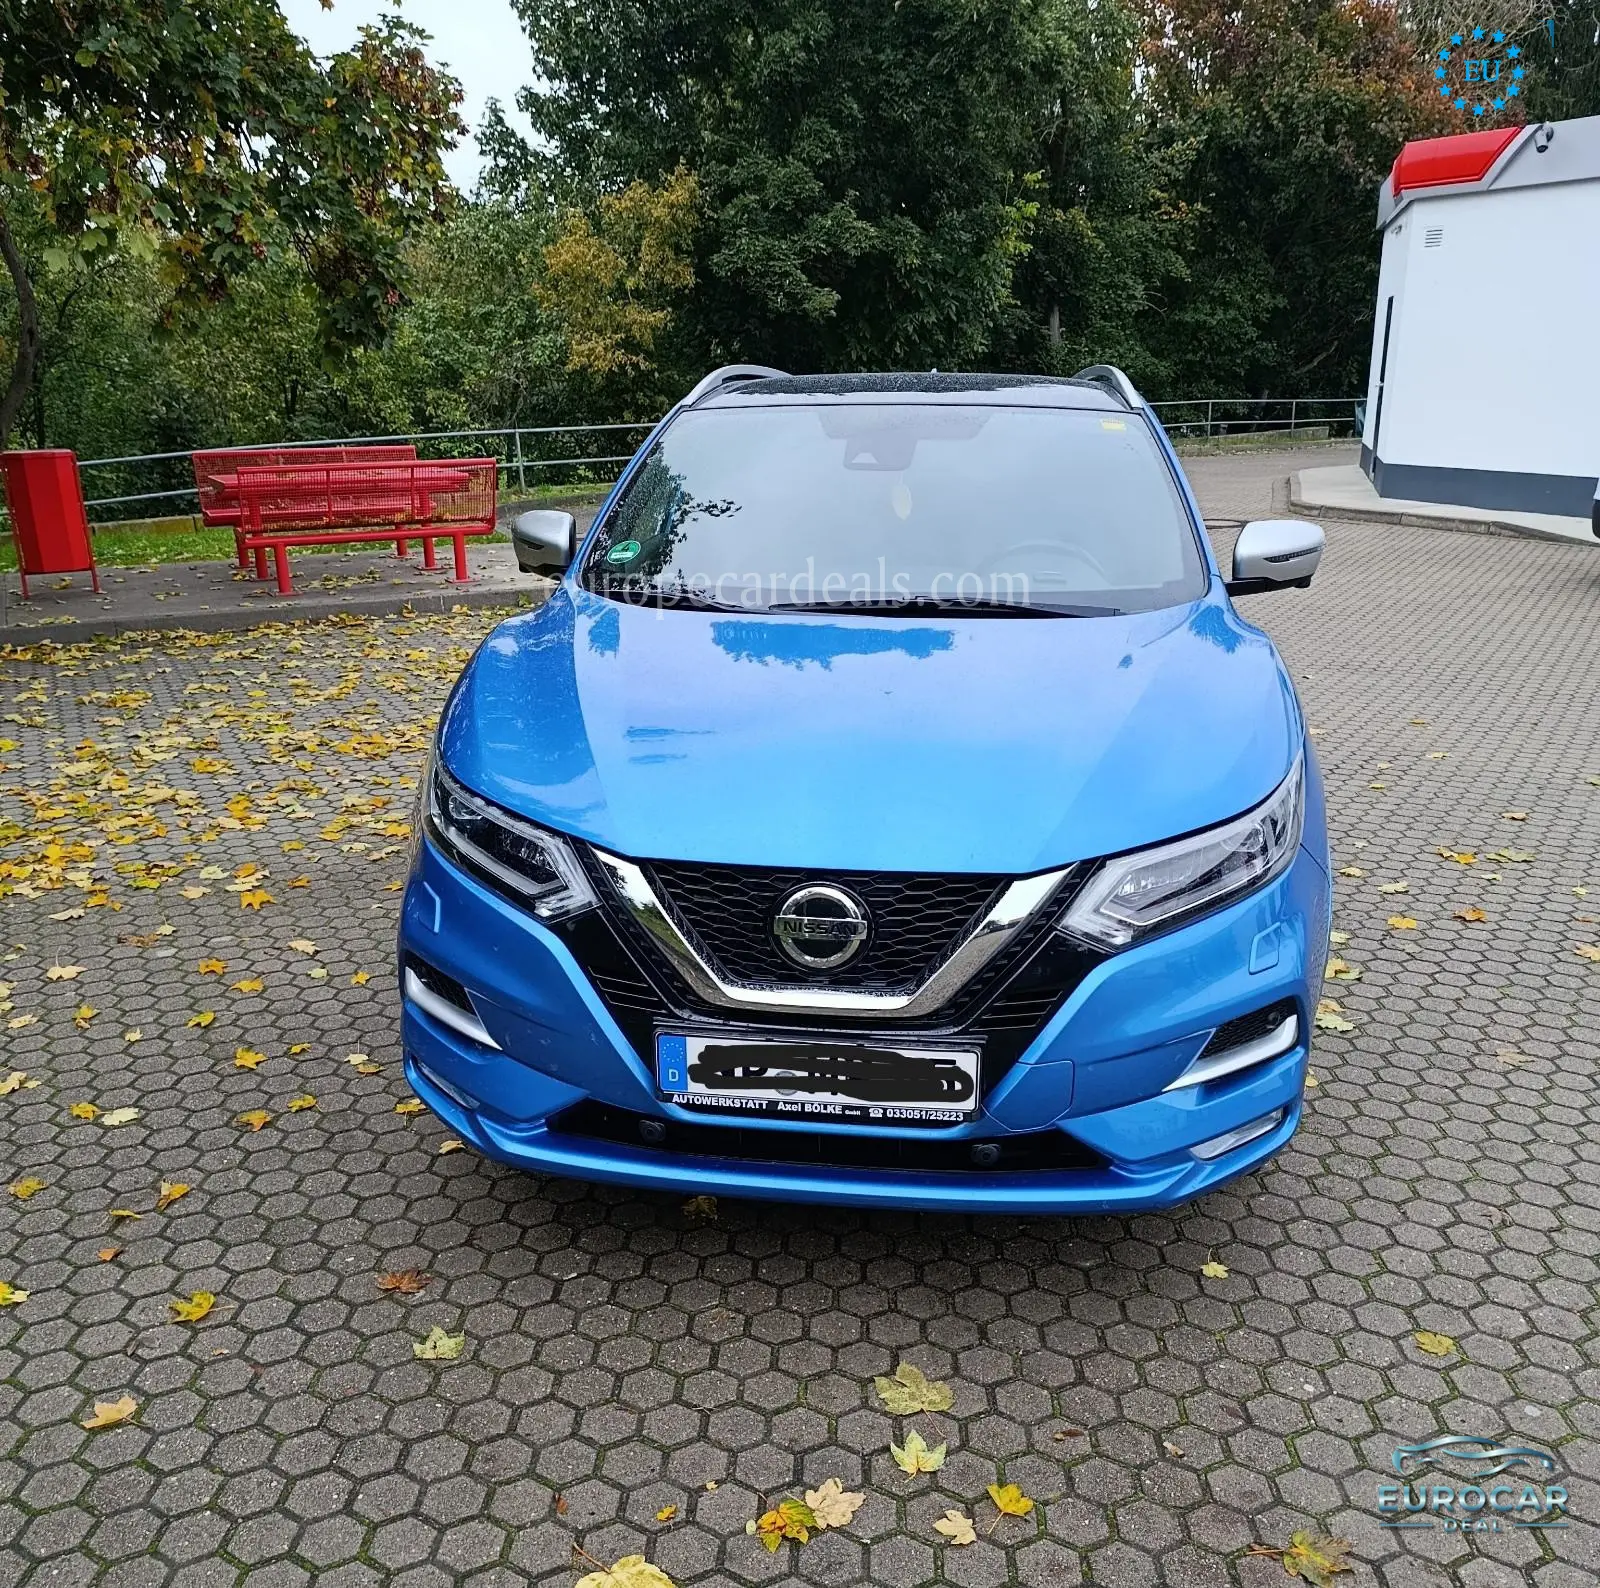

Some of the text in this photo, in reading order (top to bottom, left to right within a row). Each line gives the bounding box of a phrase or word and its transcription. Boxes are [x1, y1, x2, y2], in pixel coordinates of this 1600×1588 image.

[783, 919, 859, 937] NISSAN
[668, 1068, 679, 1082] D
[671, 1093, 769, 1110] AUTOWERKSTATT
[777, 1101, 802, 1112] Axel
[804, 1101, 843, 1115] BÖLKE
[886, 1107, 964, 1121] 033051/25223
